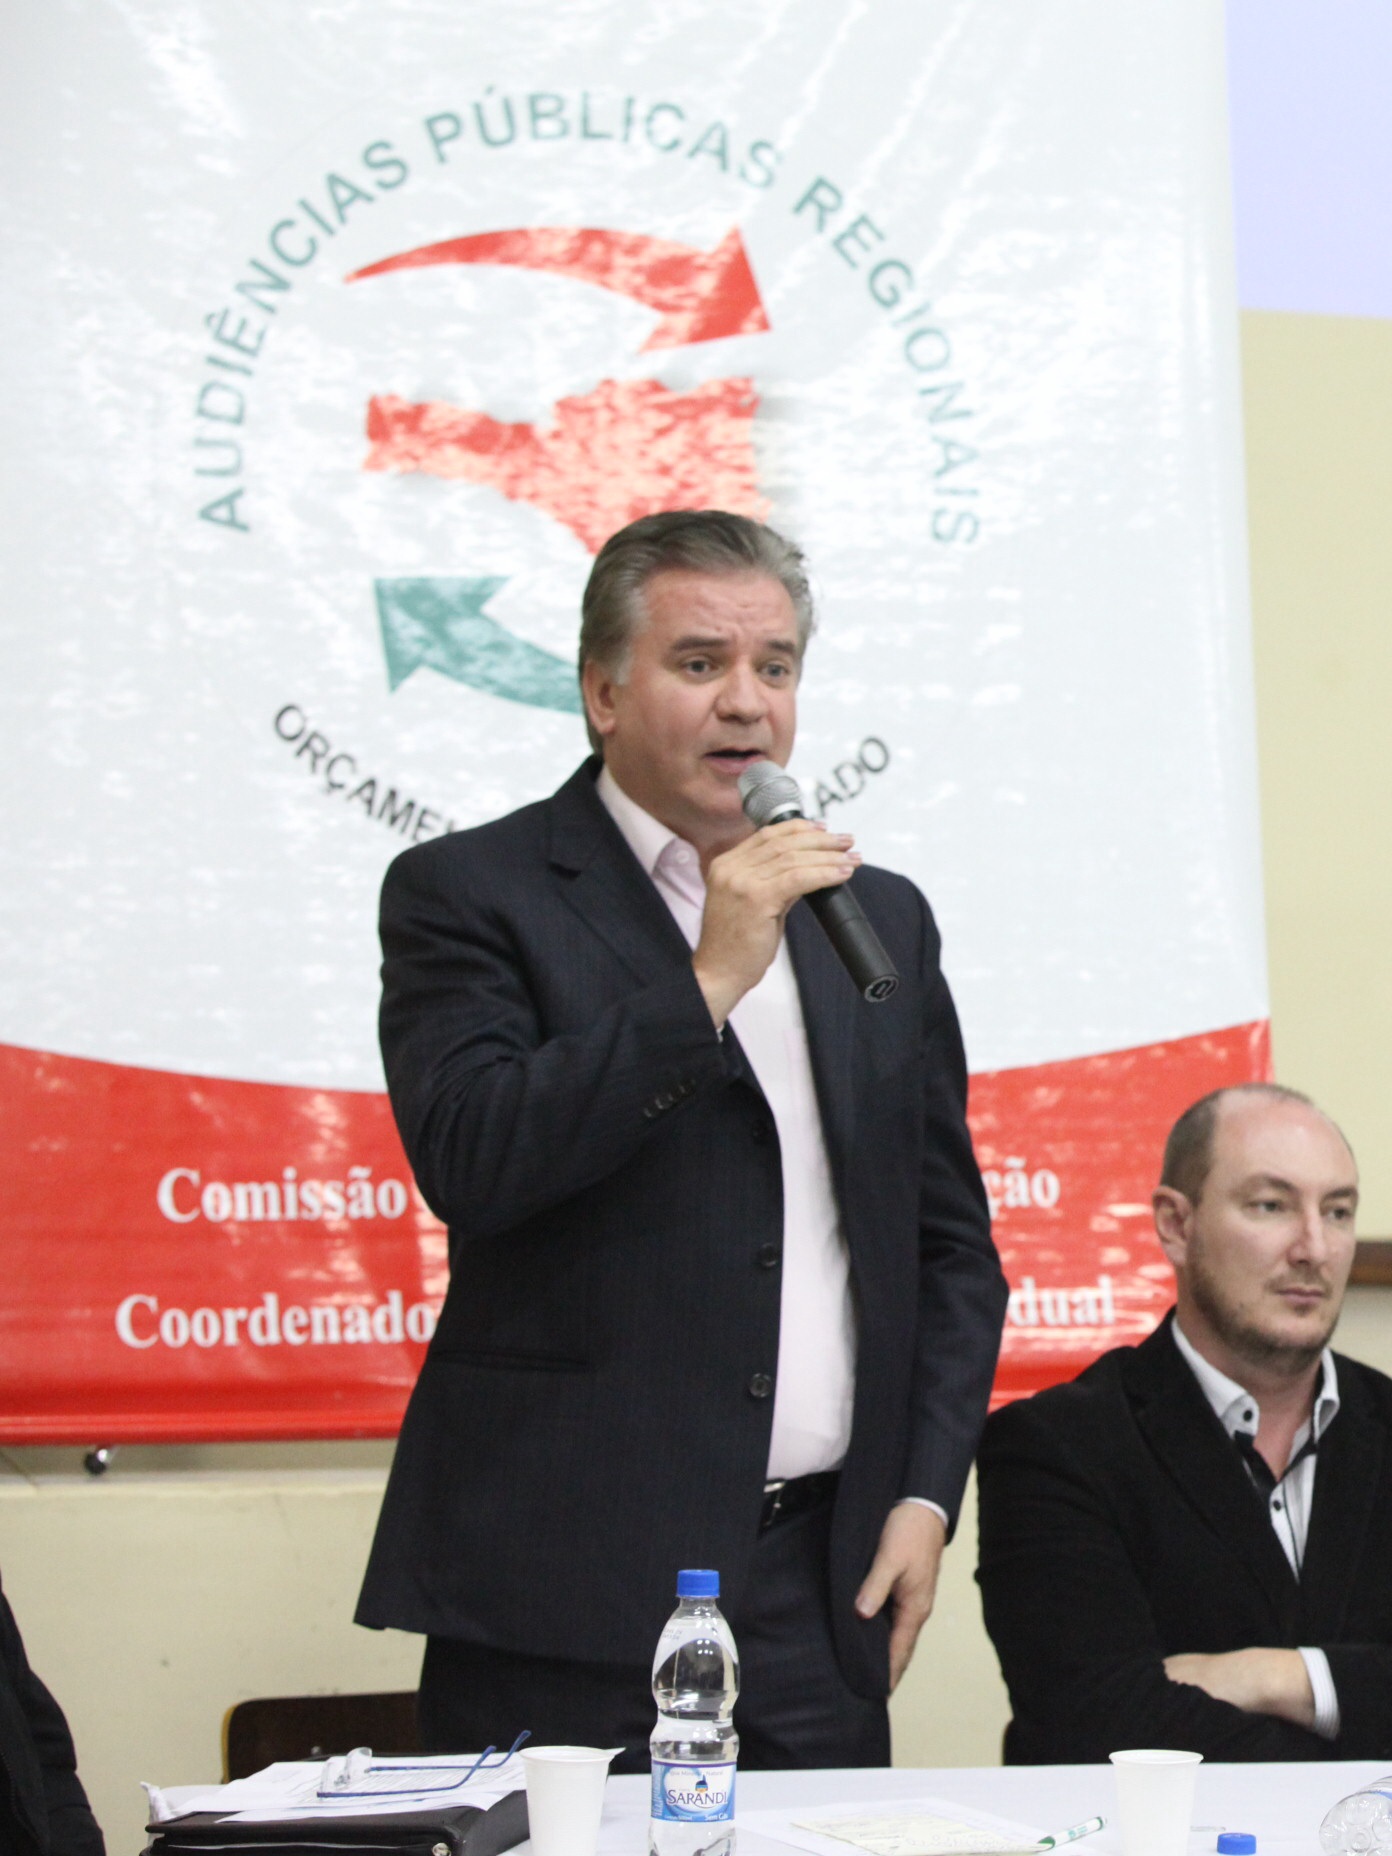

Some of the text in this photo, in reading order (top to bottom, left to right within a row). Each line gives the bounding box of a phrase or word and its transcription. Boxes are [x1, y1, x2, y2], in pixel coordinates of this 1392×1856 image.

[193, 85, 981, 546] AUDIÊNCIAS PÚBLICAS REGIONAIS
[274, 704, 890, 844] ORÇAME ADO
[156, 1155, 1061, 1224] Comissão ção
[114, 1276, 1115, 1349] Coordenado dual
